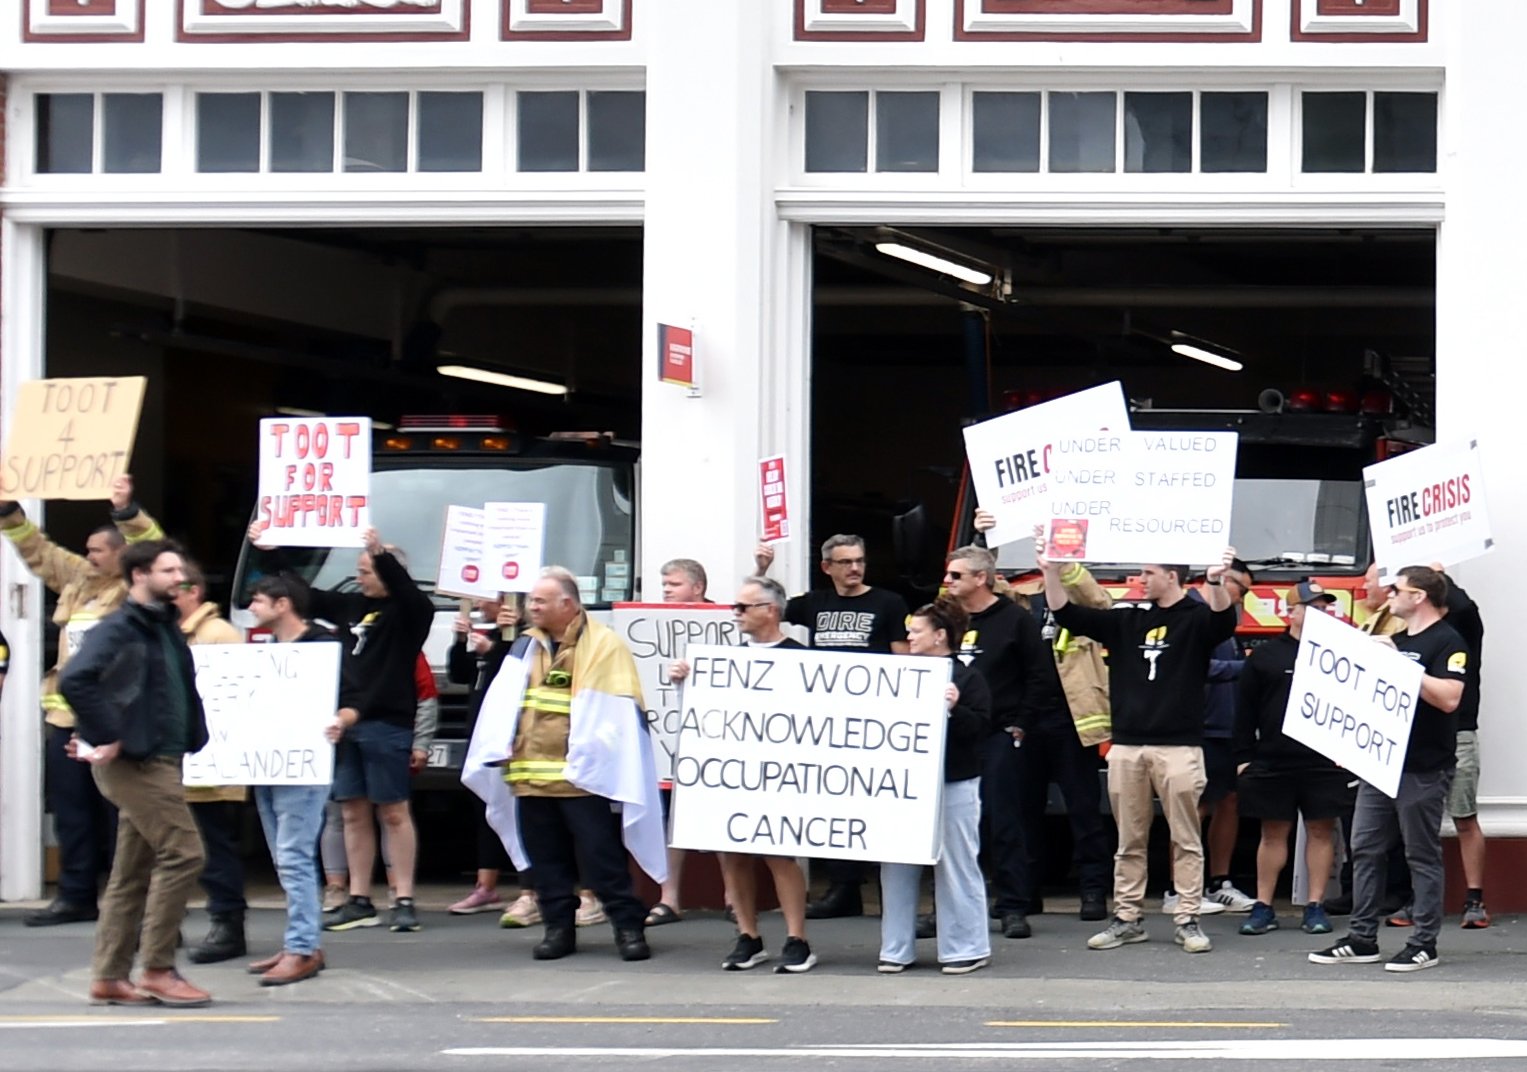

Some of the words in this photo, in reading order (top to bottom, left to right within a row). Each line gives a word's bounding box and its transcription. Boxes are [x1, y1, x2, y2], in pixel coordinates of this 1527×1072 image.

[41, 382, 117, 414] TOOT
[57, 417, 75, 451] 4
[270, 423, 360, 459] TOOT
[1059, 437, 1121, 453] UNDER
[1144, 437, 1217, 452] VALUED
[5, 451, 126, 493] SUPPORT
[285, 462, 334, 492] FOR
[994, 449, 1043, 488] FIRE
[1055, 469, 1116, 485] UNDER
[1135, 472, 1217, 488] STAFFED
[259, 494, 366, 528] SUPPORT
[1001, 485, 1034, 505] support
[1037, 483, 1048, 494] us
[1051, 500, 1112, 516] UNDER
[1387, 491, 1420, 528] FIRE
[1422, 474, 1471, 516] CRISIS
[1109, 518, 1224, 534] RESOURCED
[816, 611, 875, 632] DIRE
[692, 657, 775, 691] FENZ
[799, 662, 931, 699] WON'T
[1307, 640, 1366, 691] TOOT
[1372, 678, 1412, 723] FOR
[680, 707, 931, 754] ACKNOWLEDGE
[1300, 692, 1397, 766] SUPPORT
[187, 748, 318, 779] EALANDER
[676, 756, 918, 800] OCCUPATIONAL
[727, 812, 867, 850] CANCER
